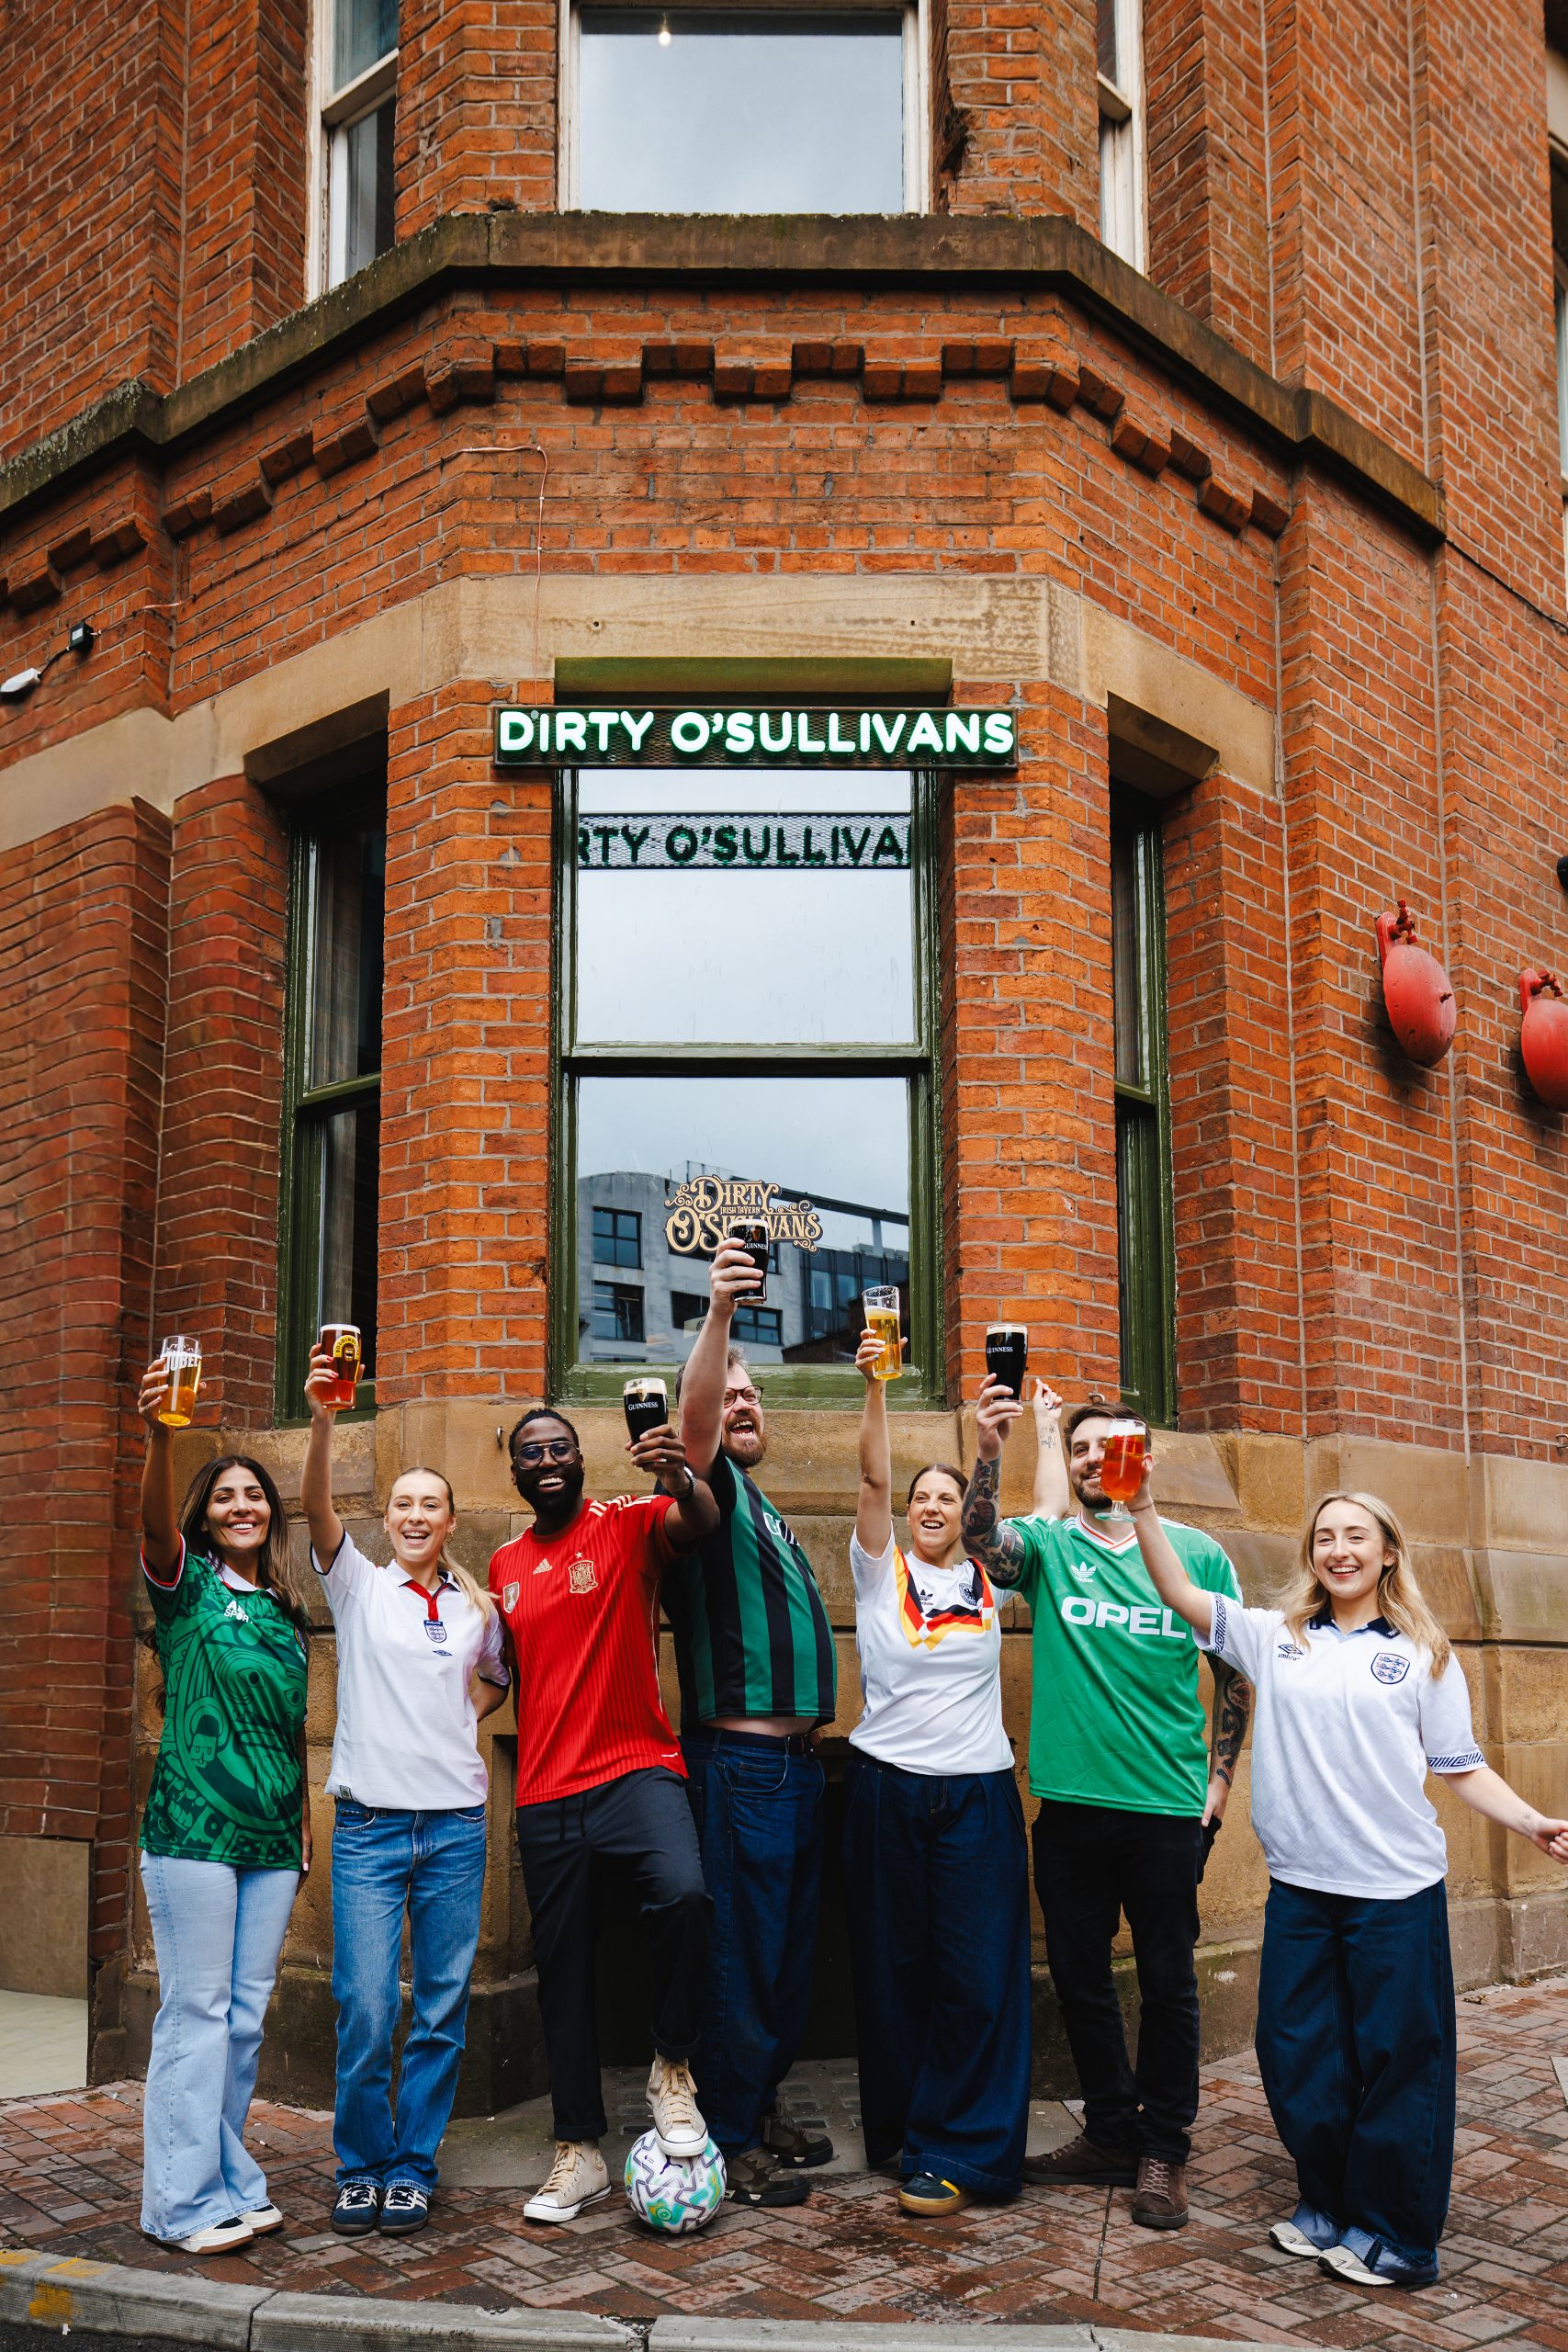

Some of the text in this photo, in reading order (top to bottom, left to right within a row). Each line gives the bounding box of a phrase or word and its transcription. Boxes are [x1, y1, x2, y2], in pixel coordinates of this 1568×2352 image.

[500, 710, 1014, 754] DIRTY O'SULLIVANS
[665, 823, 911, 864] O'SULLIVA
[690, 1175, 779, 1214] DIRTY
[665, 1205, 821, 1252] O'SUVANS
[335, 1337, 360, 1355] BODDING
[628, 1401, 659, 1411] GUINNESS
[224, 1609, 254, 1624] SPOR
[1061, 1596, 1187, 1640] OPEL
